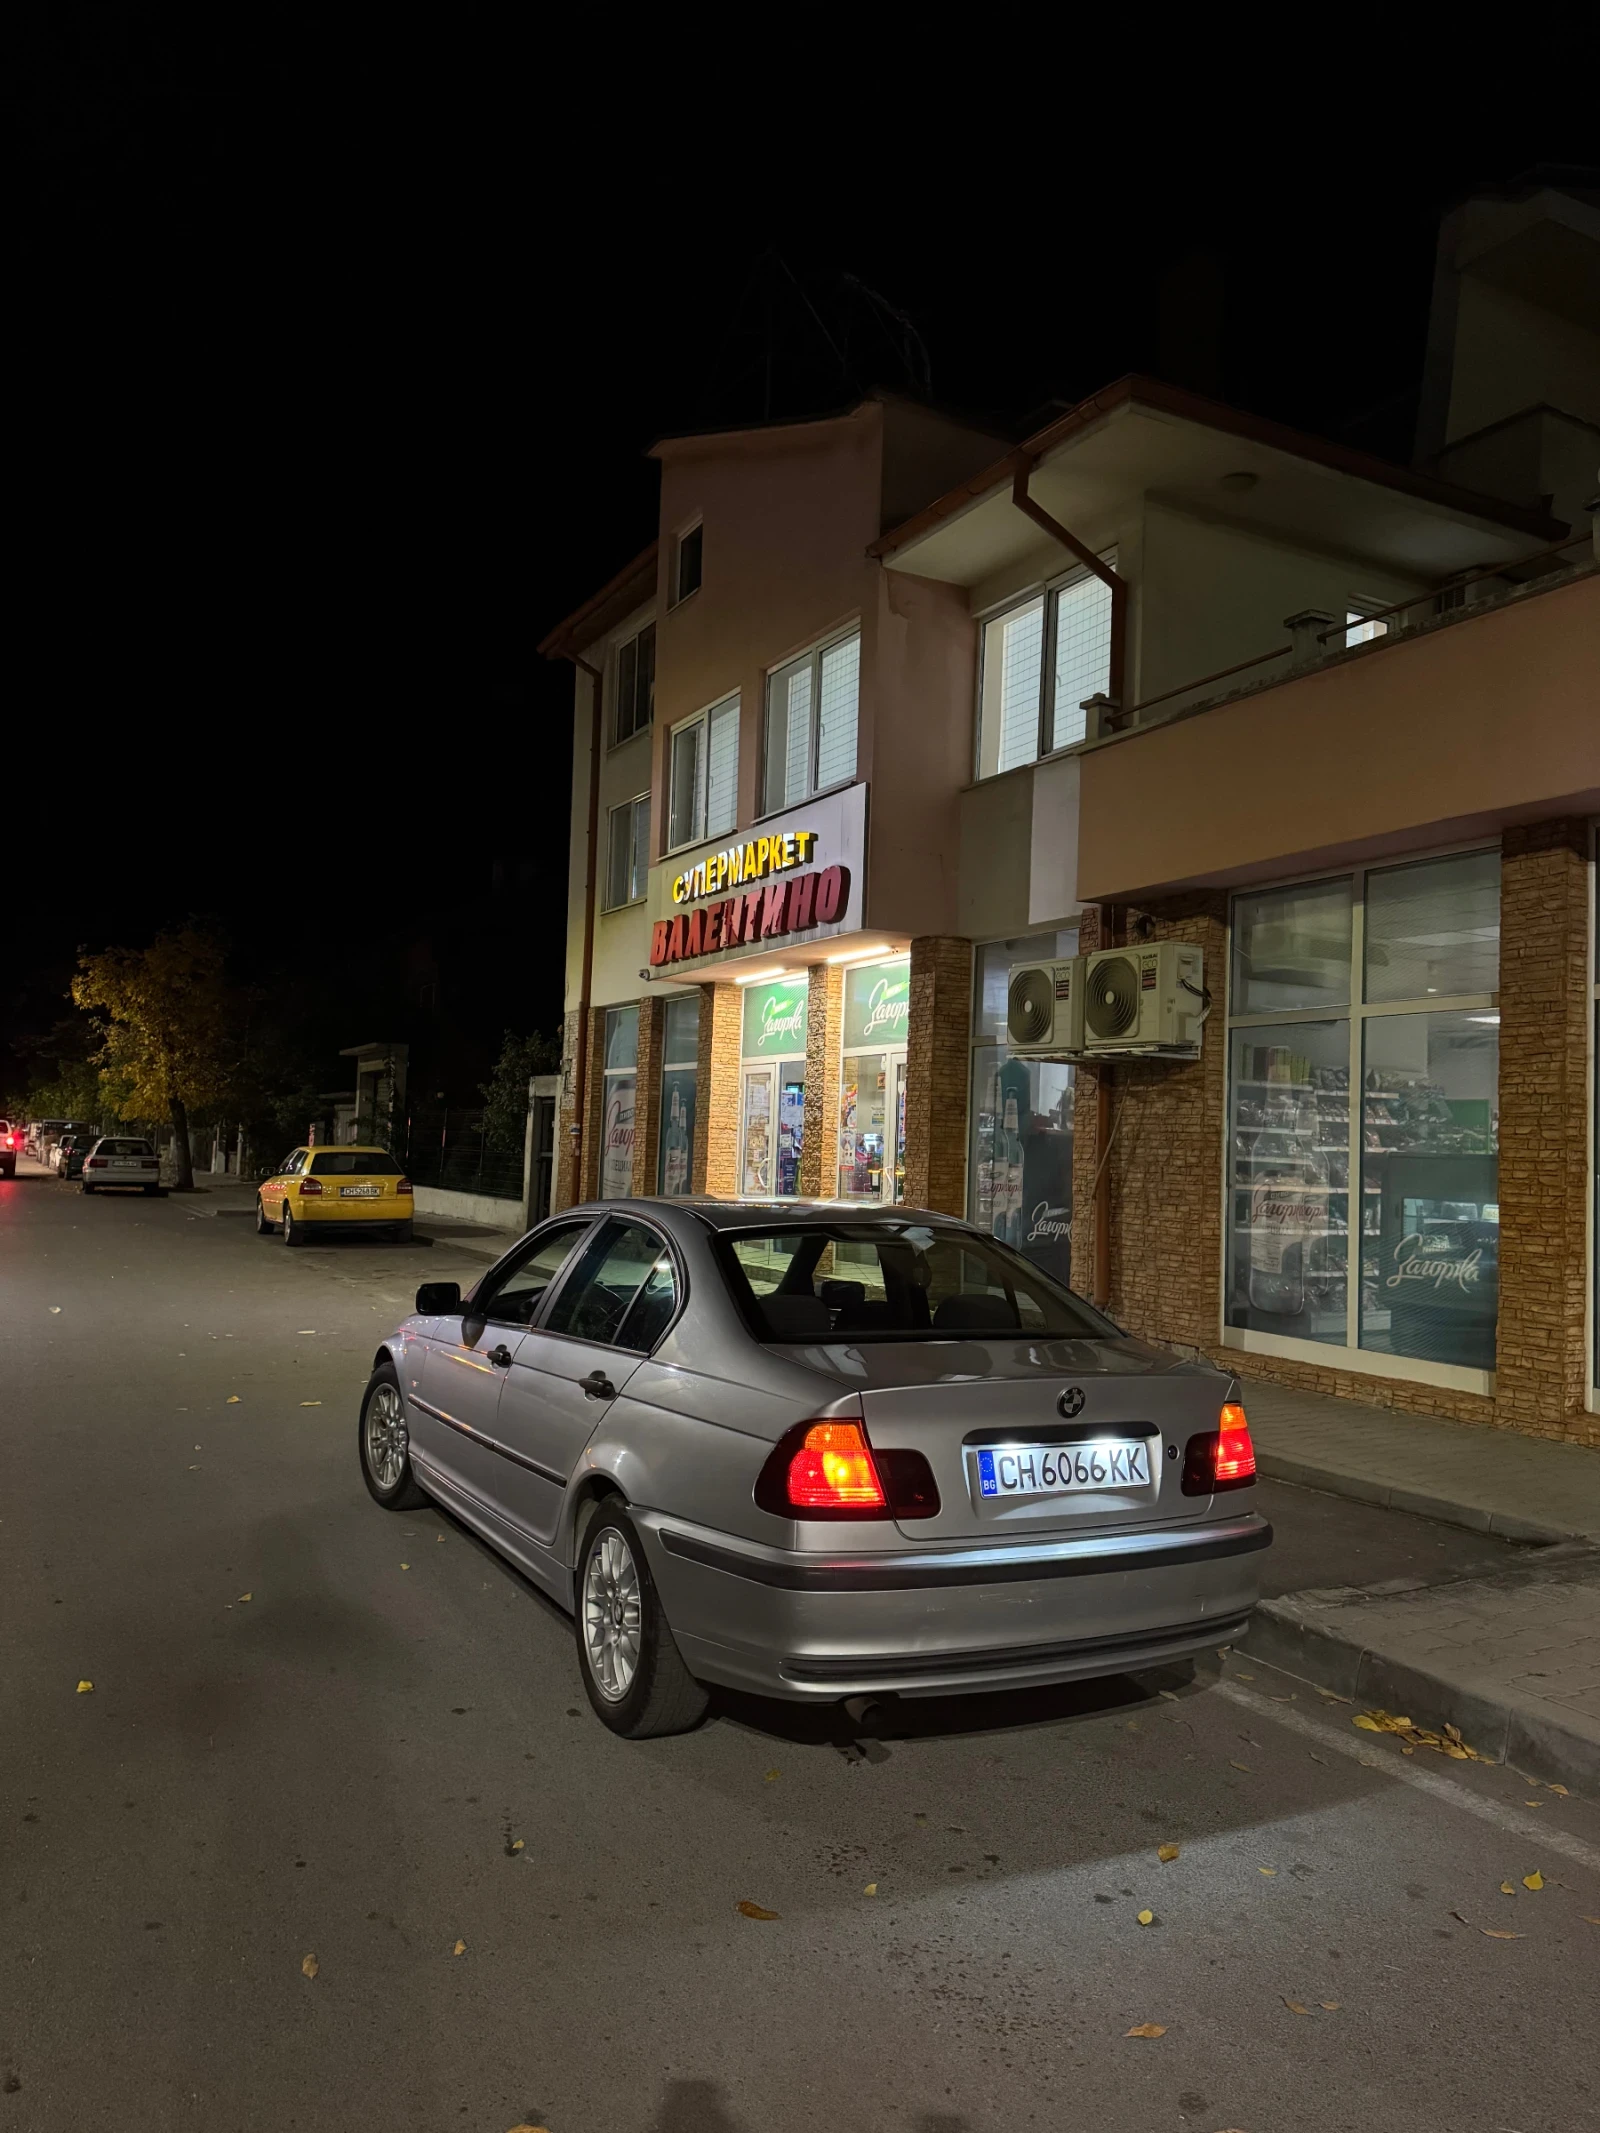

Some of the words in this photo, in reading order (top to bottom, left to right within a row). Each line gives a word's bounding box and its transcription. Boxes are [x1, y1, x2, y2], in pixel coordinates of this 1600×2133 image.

[671, 832, 813, 904] СУПЕРМАРКЕТ
[650, 865, 849, 967] ВАЛЕНТИНО
[983, 1479, 996, 1491] BG
